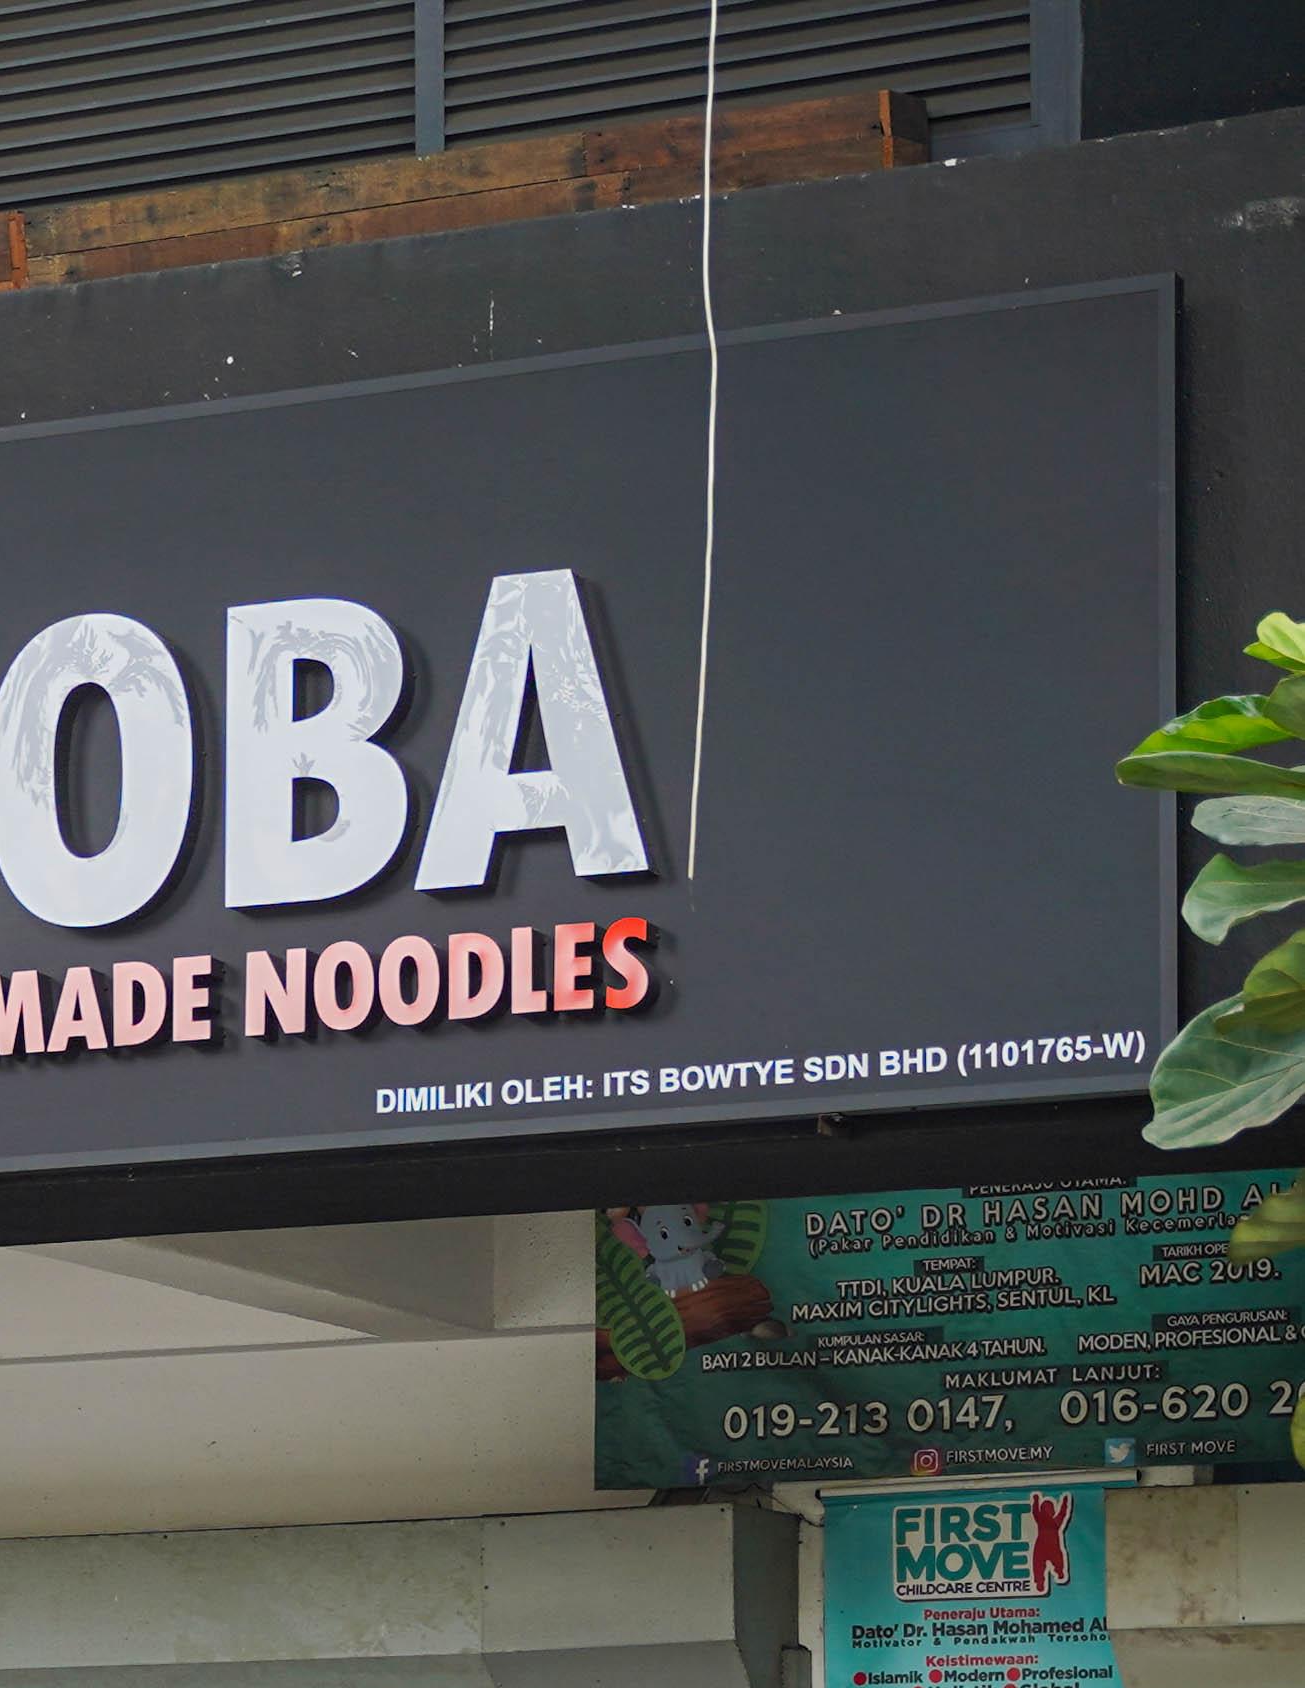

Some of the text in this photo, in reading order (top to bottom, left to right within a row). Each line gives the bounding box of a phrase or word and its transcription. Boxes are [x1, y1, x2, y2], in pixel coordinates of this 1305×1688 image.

[245, 917, 650, 1038] NOODLES
[375, 1030, 1146, 1115] DIMILIKI OLEH: ITS BOWTYE SDN BHD (1101765-W)
[805, 1205, 903, 1237] DATO'
[921, 1203, 966, 1229] DR
[983, 1194, 1102, 1225] HASAN
[1120, 1185, 1222, 1216] MOHD
[810, 1237, 872, 1256] (Pakar
[882, 1227, 994, 1248] Pendidikan
[1005, 1227, 1017, 1240] &
[1027, 1221, 1115, 1238] Motivasi
[1161, 1243, 1230, 1258] TARIKH OPE
[923, 1257, 976, 1272] TEMPAT:
[1140, 1257, 1280, 1285] MAC 2019.
[836, 1266, 1060, 1299] TTDI, KUALA LUMPUR.
[792, 1286, 1115, 1321] MAXIM CITYLIGHTS, SENTUL, KL
[1166, 1310, 1288, 1327] GAYA PENGURUSAN:
[817, 1332, 925, 1348] KUMPULAN SASAR:
[1078, 1324, 1298, 1352] MODEN, PROFESIONAL &
[702, 1353, 738, 1371] BAYI
[741, 1351, 752, 1368] 2
[755, 1350, 817, 1367] BULAN
[833, 1341, 965, 1366] KANAK-KANAK
[966, 1340, 979, 1356] 4
[981, 1338, 1046, 1356] TAHUN.
[945, 1364, 1161, 1389] MAKLUMAT LANJUT:
[723, 1401, 889, 1440] 019-213
[906, 1395, 1014, 1433] 0147,
[1060, 1382, 1250, 1425] 016-620
[1146, 1439, 1236, 1457] FIRST MOVE
[717, 1456, 854, 1473] FIRSTMOVEMALAYSIA
[895, 1503, 1032, 1545] FIRST
[895, 1541, 1031, 1583] MOVE
[896, 1580, 1031, 1597] CHILDCARE CENTRE
[923, 1607, 1041, 1623] Peneraju Utama:
[851, 1624, 900, 1640] Dato'
[902, 1624, 928, 1638] Dr.
[932, 1621, 989, 1637] Hasan
[992, 1617, 1085, 1635] Mohamed
[852, 1638, 922, 1649] Motivator
[953, 1634, 1036, 1646] Pendakwah
[925, 1653, 1040, 1668] Keistimewaan:
[868, 1664, 1114, 1685] Islamik Modern Profesional
